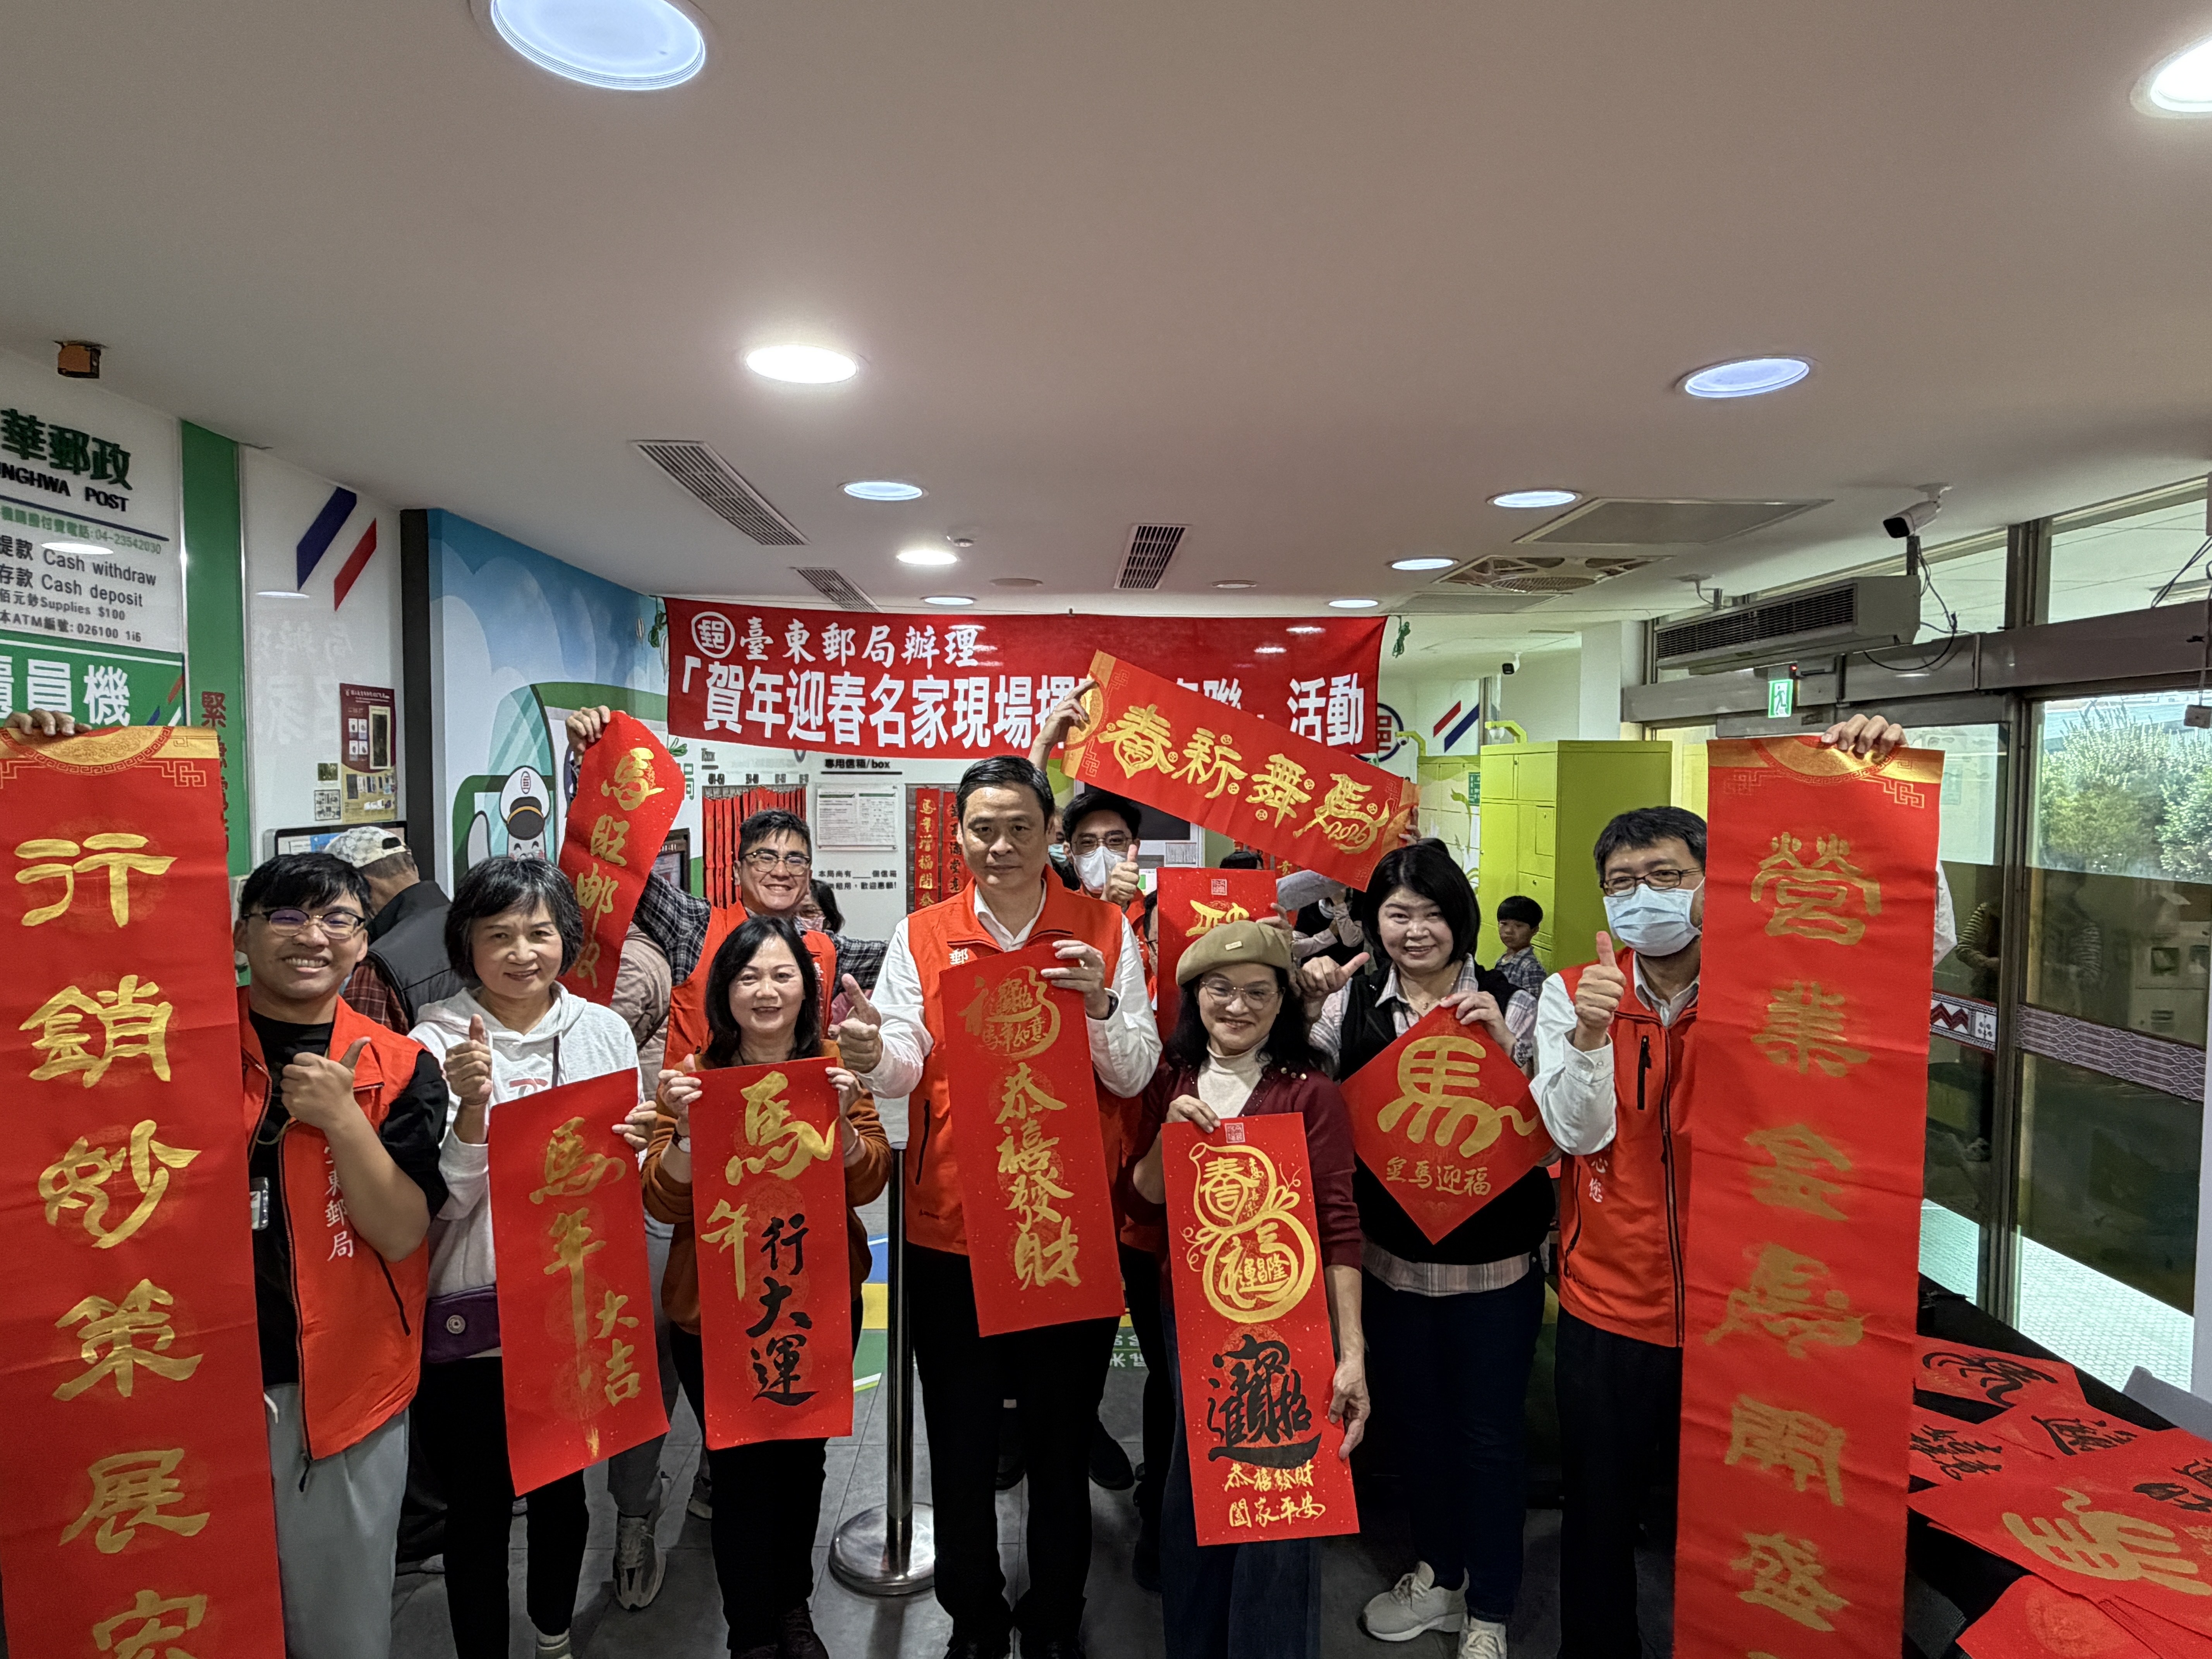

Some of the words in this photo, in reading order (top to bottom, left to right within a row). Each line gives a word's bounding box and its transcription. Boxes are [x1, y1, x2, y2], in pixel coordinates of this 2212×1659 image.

[1, 409, 133, 490] 華郵政
[0, 462, 71, 496] NGHWA
[84, 486, 129, 512] POST
[41, 574, 82, 596] Cash
[90, 584, 143, 607] deposit
[44, 548, 85, 572] Cash
[93, 561, 156, 586] withdraw
[77, 623, 119, 639] 026100
[98, 606, 125, 620] $100
[740, 617, 978, 669] 臺東郵局辦理
[948, 948, 969, 965] 郵
[1377, 1036, 1537, 1158] 馬
[324, 1146, 354, 1261] 東郵局
[745, 1212, 819, 1407] 行大運
